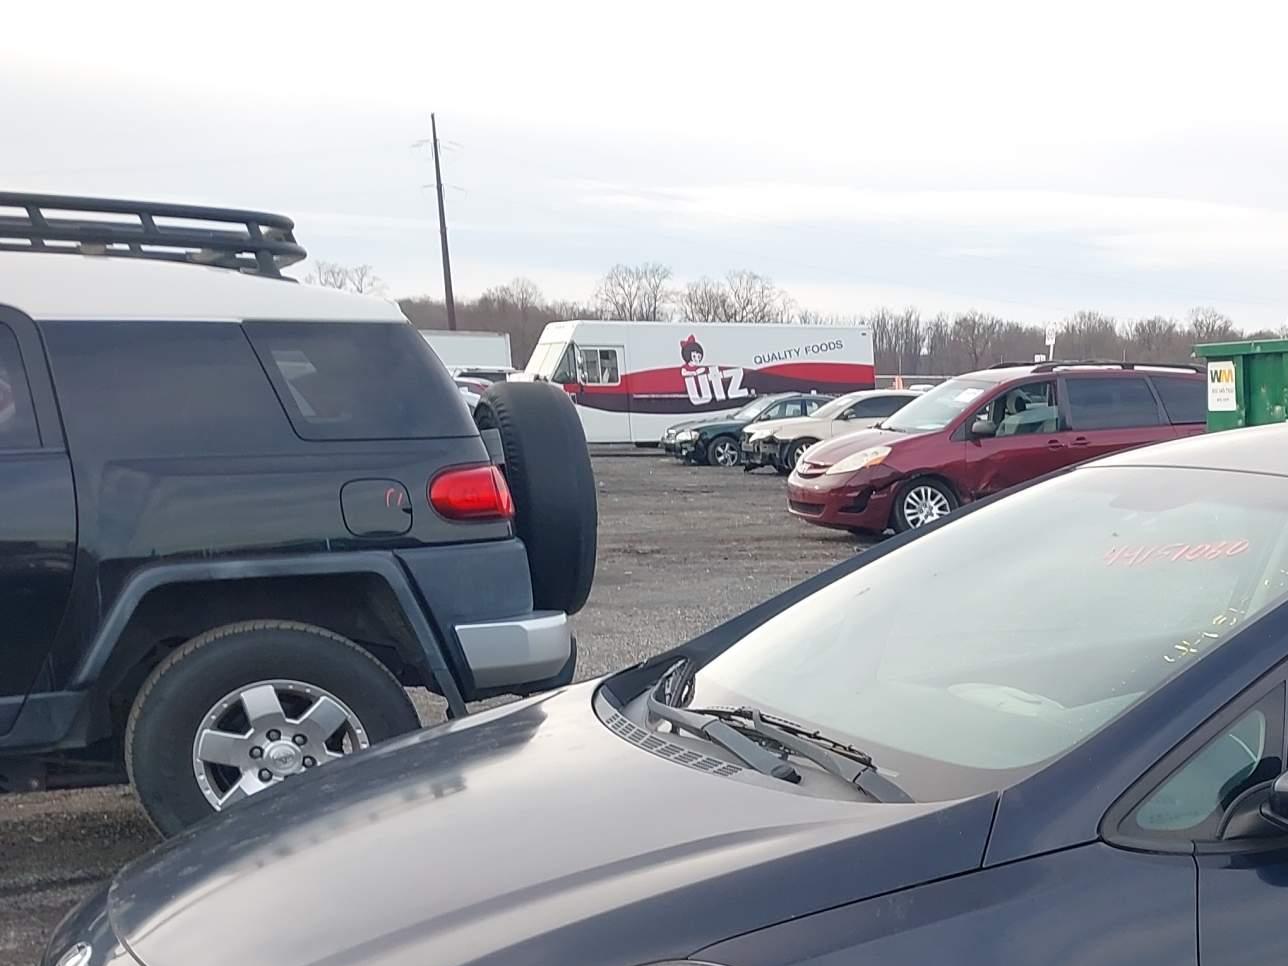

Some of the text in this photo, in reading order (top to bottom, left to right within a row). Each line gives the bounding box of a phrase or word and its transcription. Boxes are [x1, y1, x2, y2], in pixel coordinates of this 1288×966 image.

[754, 339, 844, 365] QUALITY FOODS
[1210, 369, 1233, 383] WM
